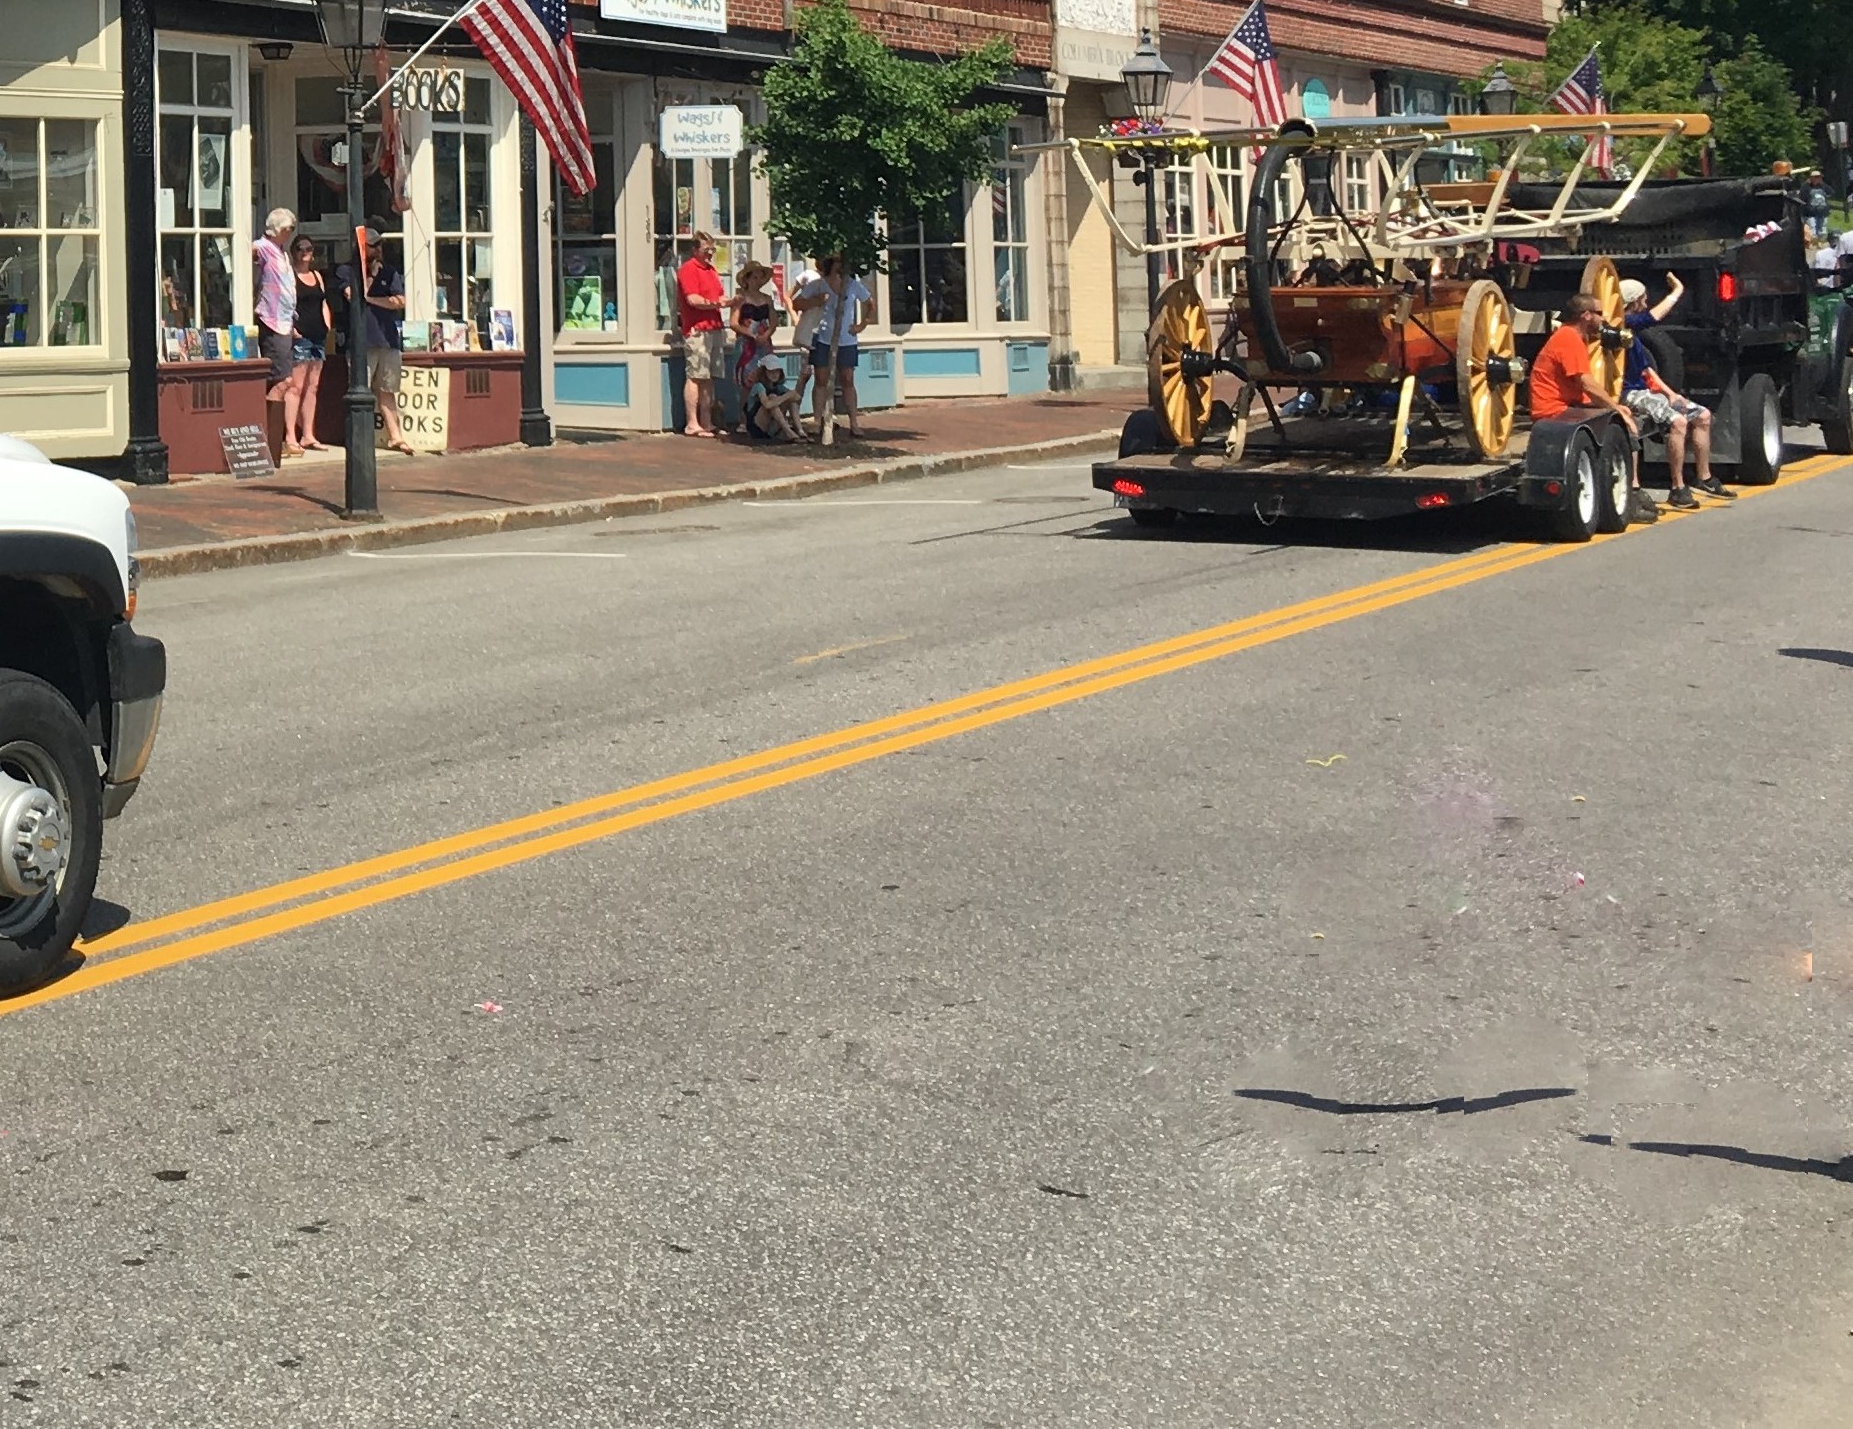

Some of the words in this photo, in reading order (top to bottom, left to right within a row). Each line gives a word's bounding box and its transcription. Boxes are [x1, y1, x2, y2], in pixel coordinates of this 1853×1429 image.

[391, 70, 461, 111] BOOKS
[399, 369, 440, 388] PEN
[397, 391, 438, 410] OOR
[374, 413, 443, 433] BOKS
